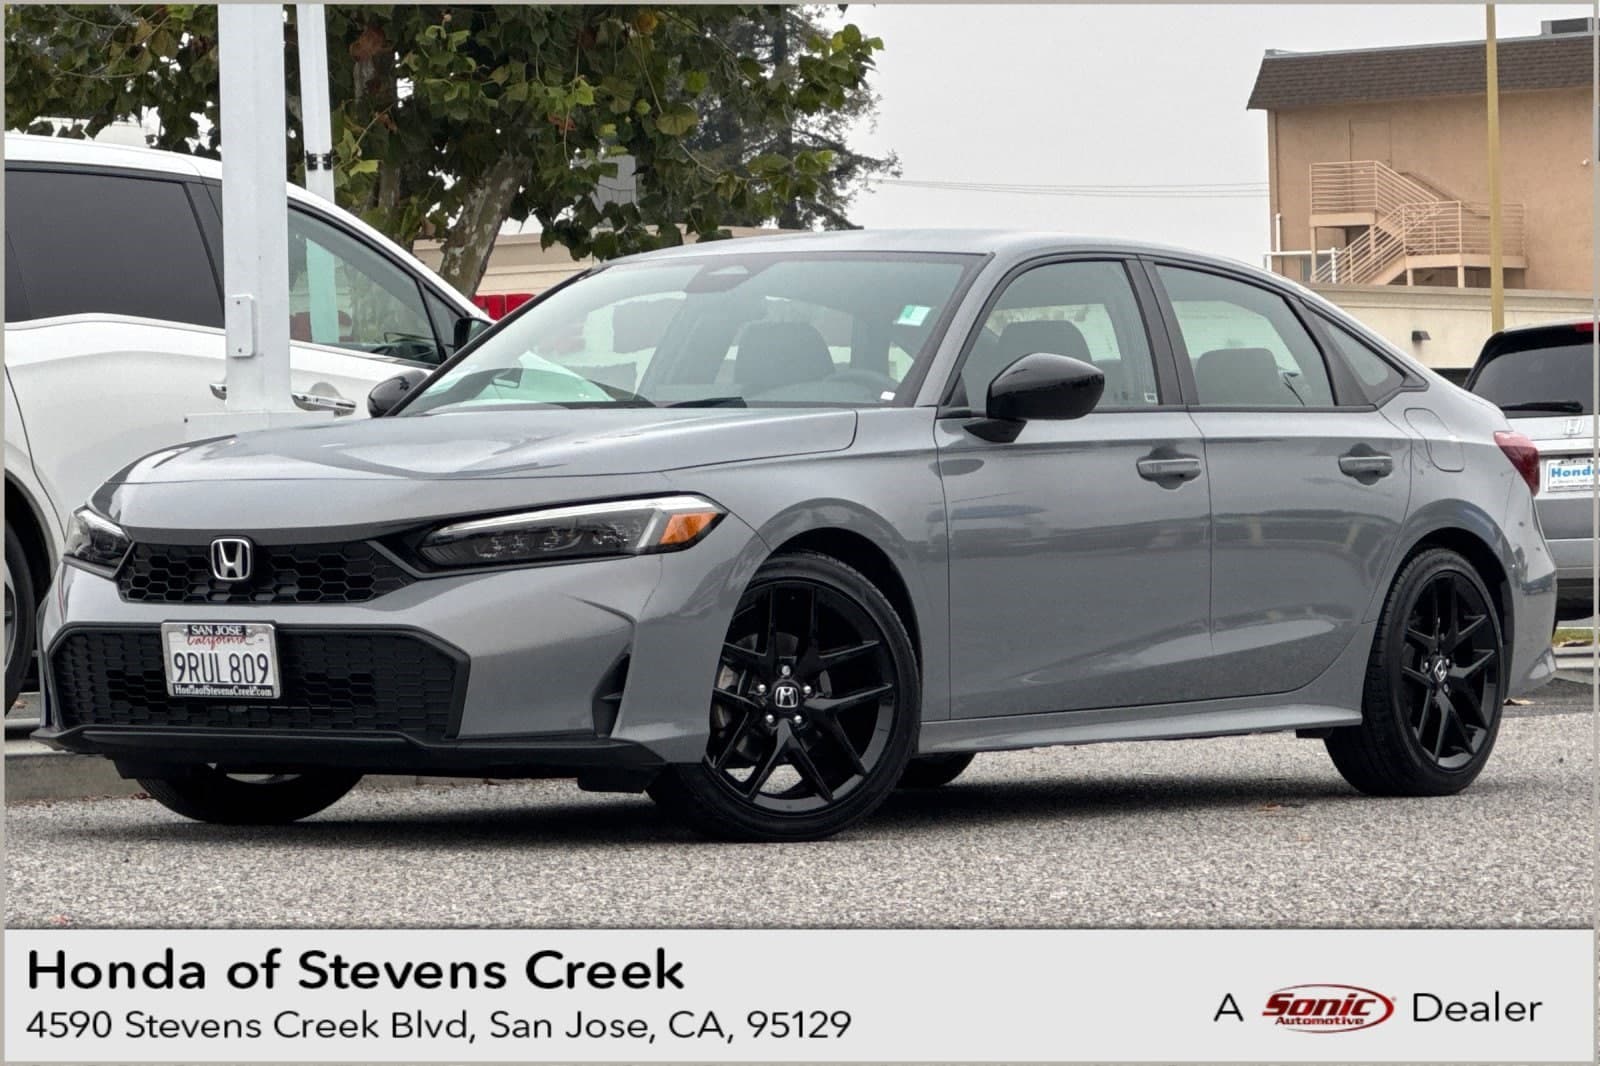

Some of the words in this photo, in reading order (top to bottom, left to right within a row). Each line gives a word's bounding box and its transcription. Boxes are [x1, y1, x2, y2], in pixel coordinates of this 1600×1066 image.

[1552, 466, 1594, 478] Hond
[191, 625, 213, 635] SAN
[215, 625, 243, 635] JOSE
[174, 652, 269, 684] 9RUL809
